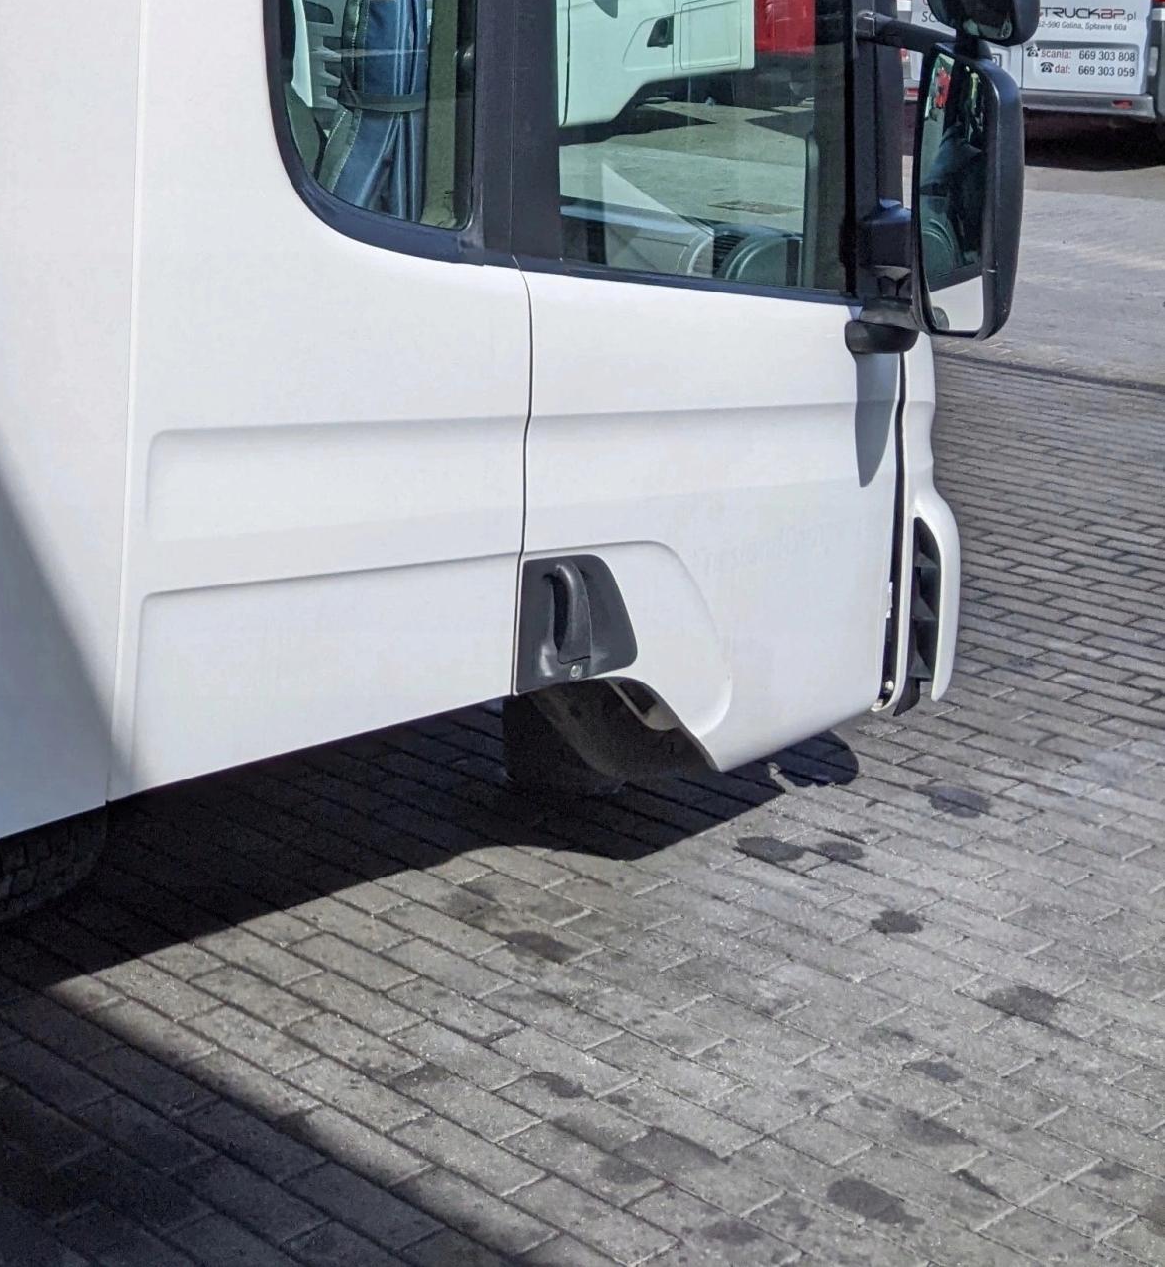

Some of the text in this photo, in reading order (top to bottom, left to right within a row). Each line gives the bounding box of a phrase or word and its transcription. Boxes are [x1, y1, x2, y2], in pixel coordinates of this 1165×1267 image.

[1041, 49, 1136, 62] scania: 669 303 808
[1078, 65, 1095, 75] 669
[1097, 66, 1115, 76] 303
[1117, 67, 1136, 77] 059
